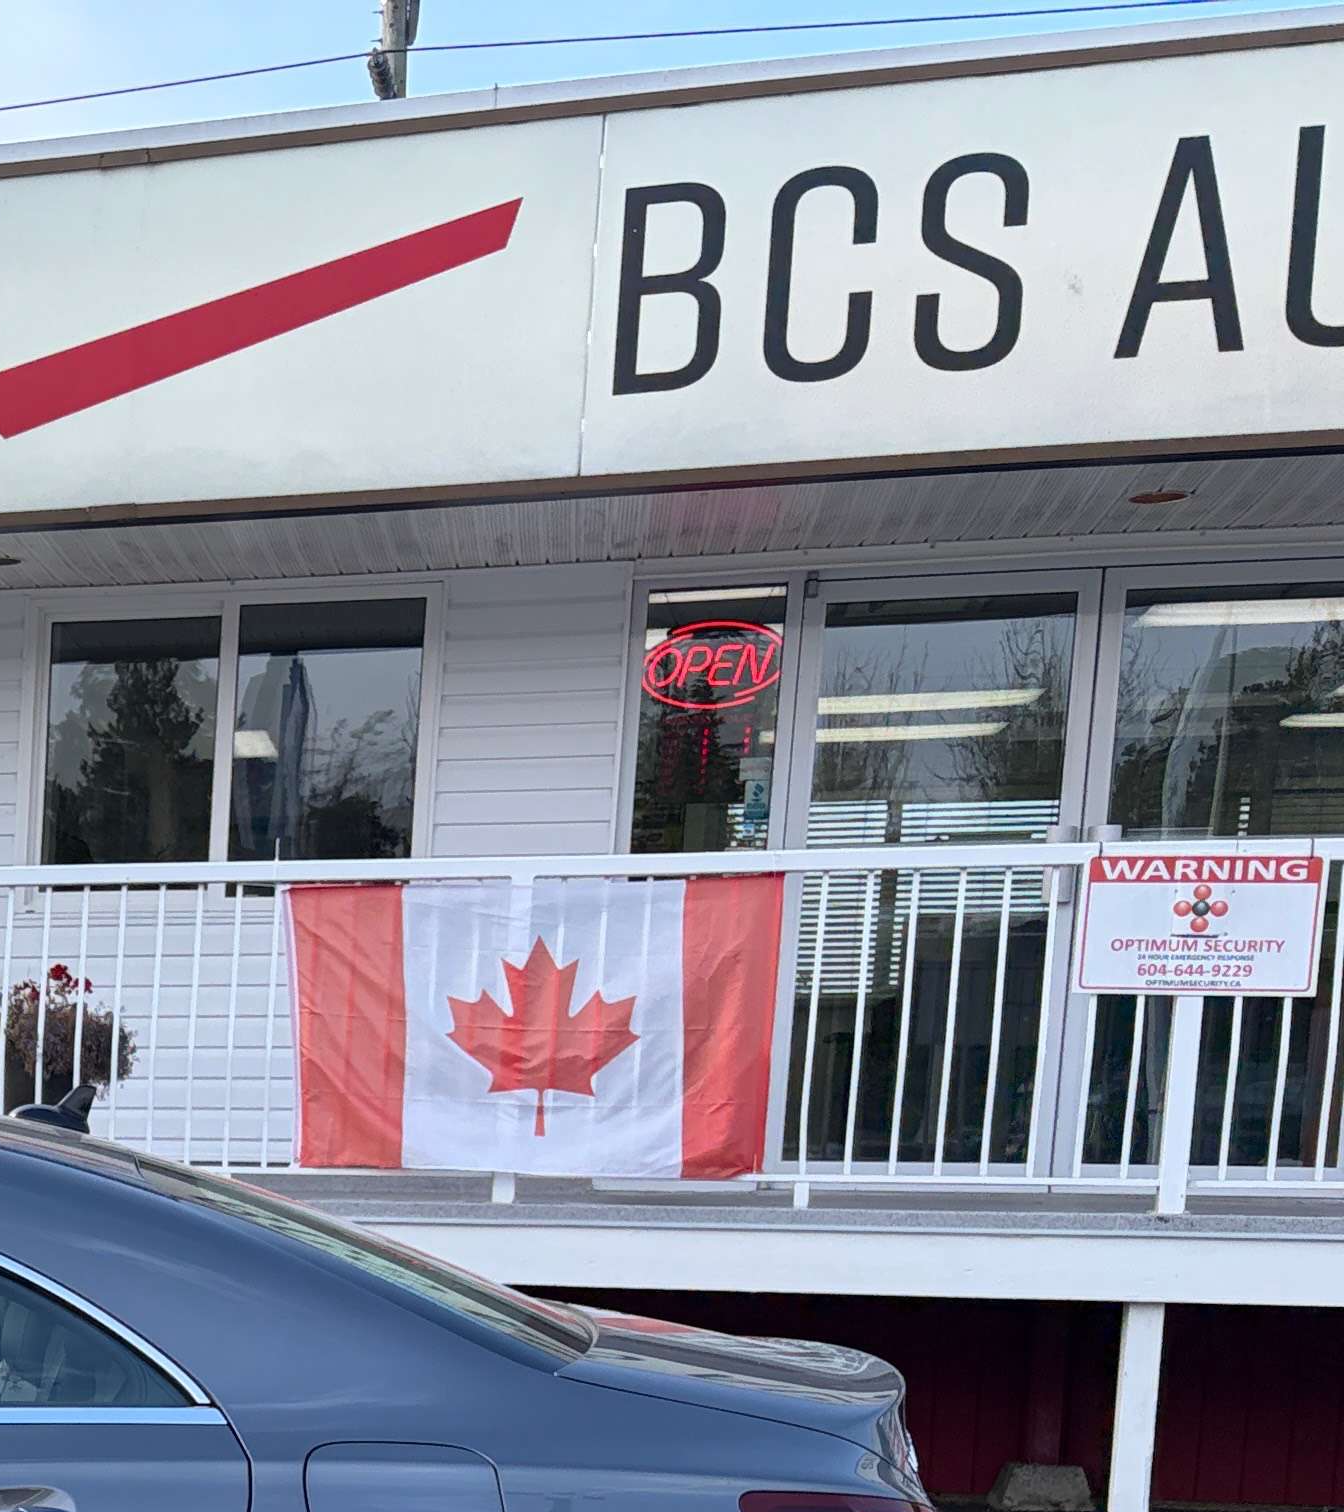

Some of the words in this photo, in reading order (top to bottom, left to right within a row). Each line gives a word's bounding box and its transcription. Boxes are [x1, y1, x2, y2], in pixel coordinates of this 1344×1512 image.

[612, 152, 1030, 395] BCS
[648, 643, 775, 688] OPEN
[1101, 859, 1309, 881] WARNING
[1110, 938, 1198, 953] OPTIMUM
[1204, 939, 1286, 954] SECURITY
[1217, 954, 1254, 962] RESPONSE
[1137, 963, 1253, 978] 604-644-9229
[1145, 979, 1242, 988] OPTIMUMSECURITY.CA
